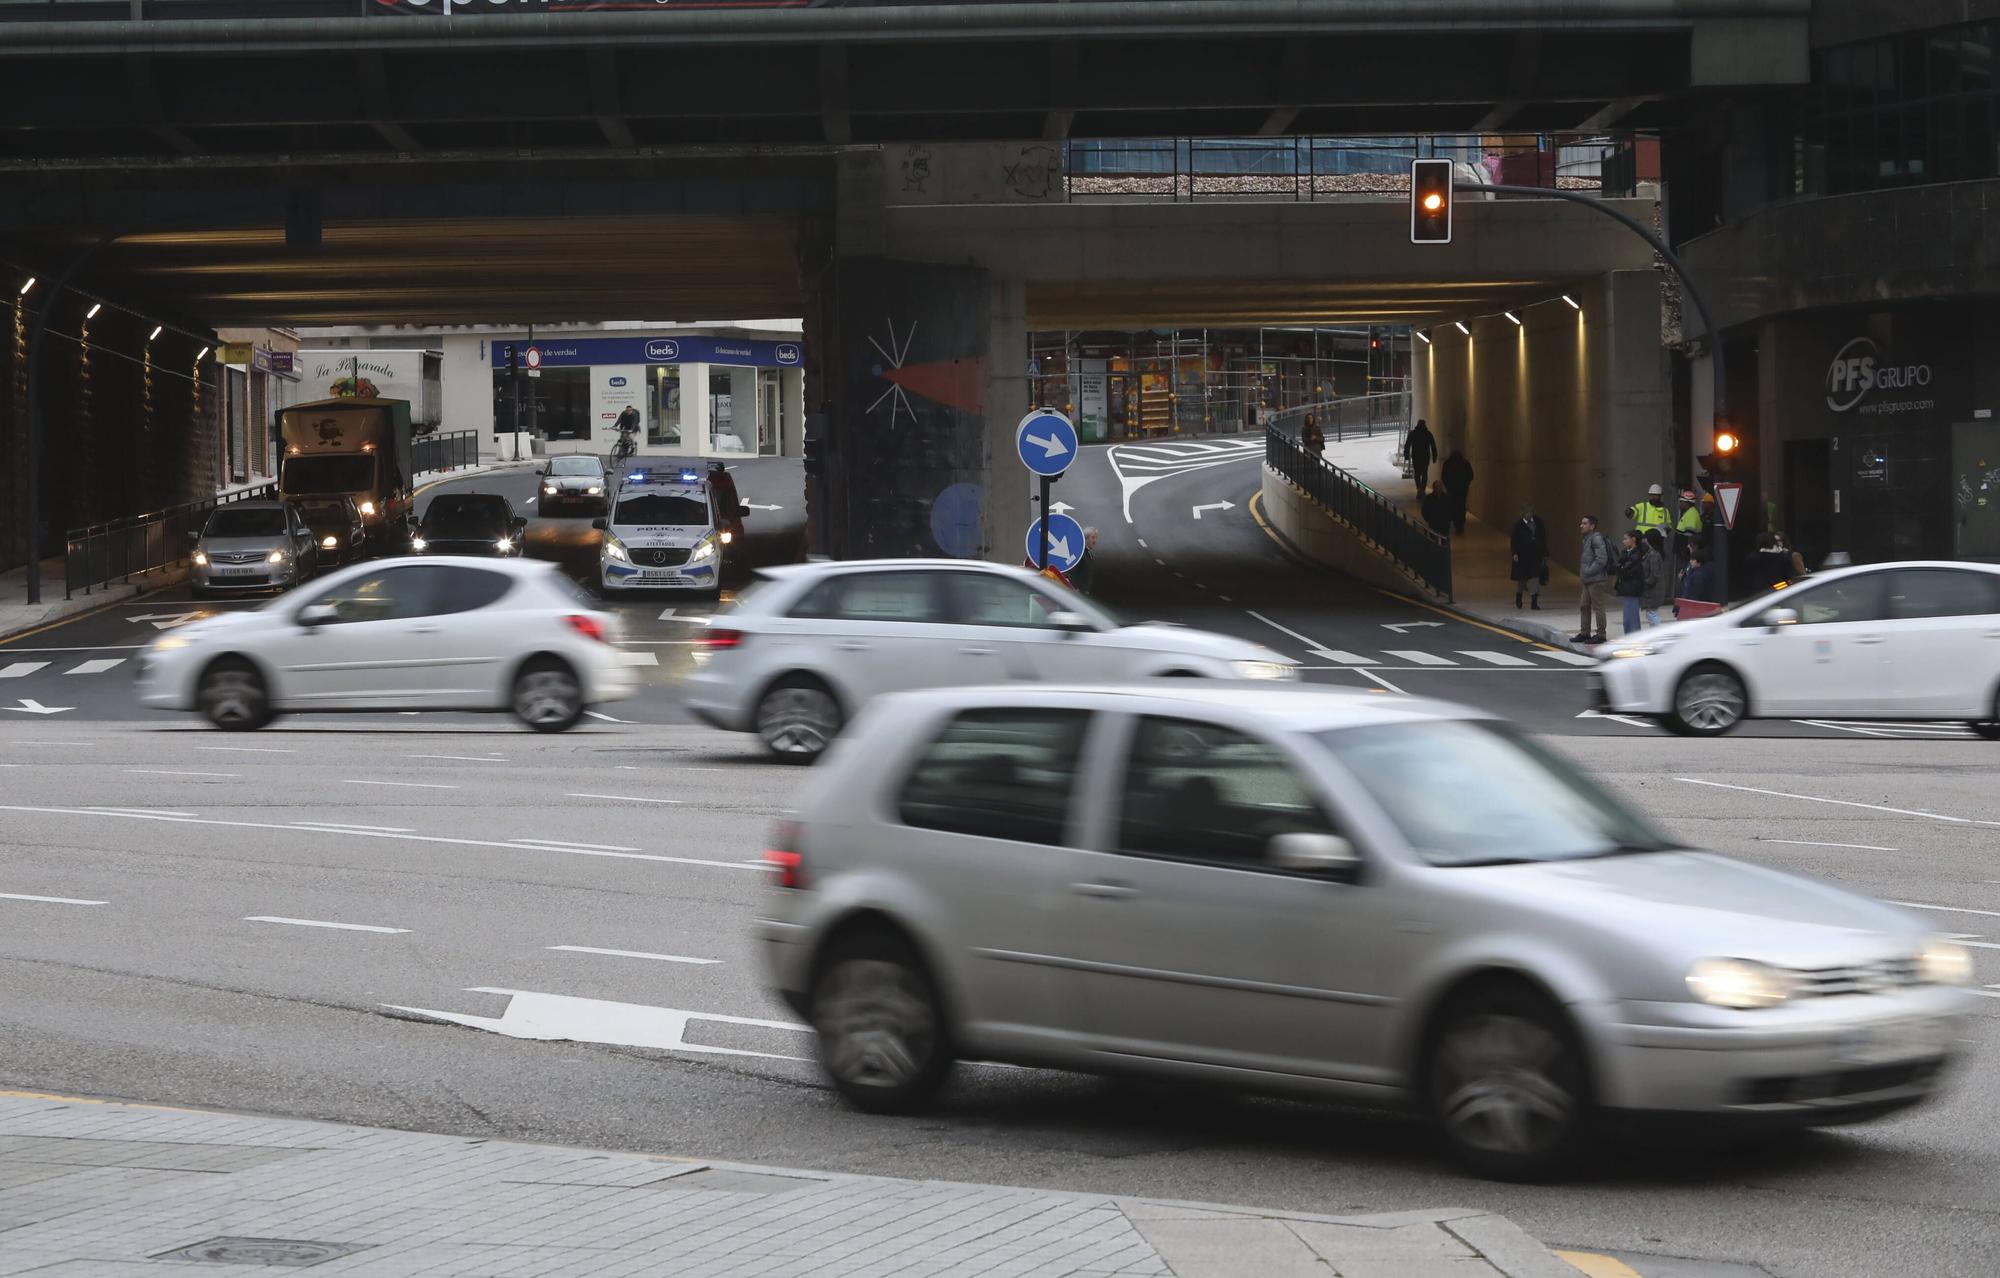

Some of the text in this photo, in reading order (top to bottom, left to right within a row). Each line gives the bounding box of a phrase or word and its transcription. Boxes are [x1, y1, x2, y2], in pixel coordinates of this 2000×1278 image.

[554, 348, 576, 356] verdad
[1831, 357, 1930, 392] PFS GRUPO
